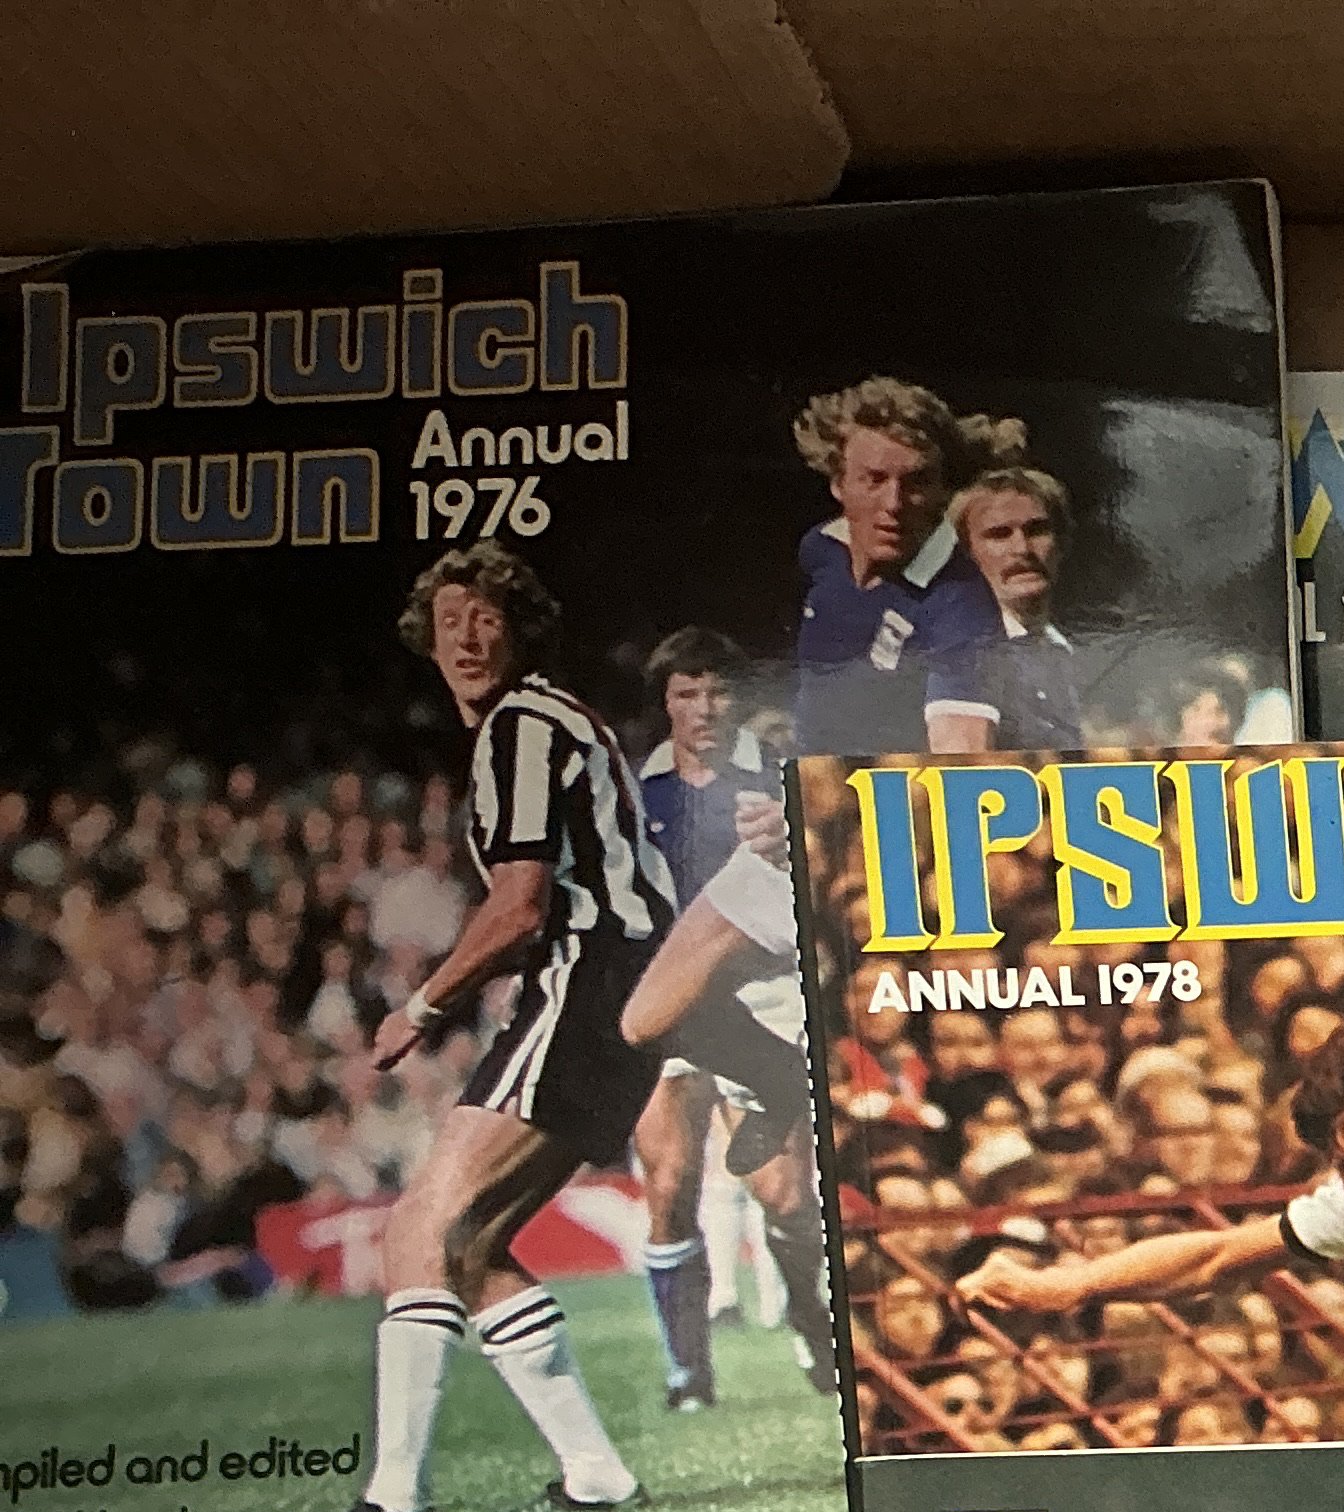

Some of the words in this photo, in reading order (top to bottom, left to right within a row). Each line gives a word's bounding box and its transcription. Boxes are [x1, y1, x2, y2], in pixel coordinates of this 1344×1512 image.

[20, 259, 629, 448] Ipswich
[411, 400, 630, 468] Annual
[0, 424, 381, 556] Town
[411, 476, 553, 541] 1976
[867, 966, 1088, 1013] ANNUAL
[1097, 960, 1203, 1006] 1978
[125, 1440, 210, 1483] and
[219, 1435, 361, 1480] edited
